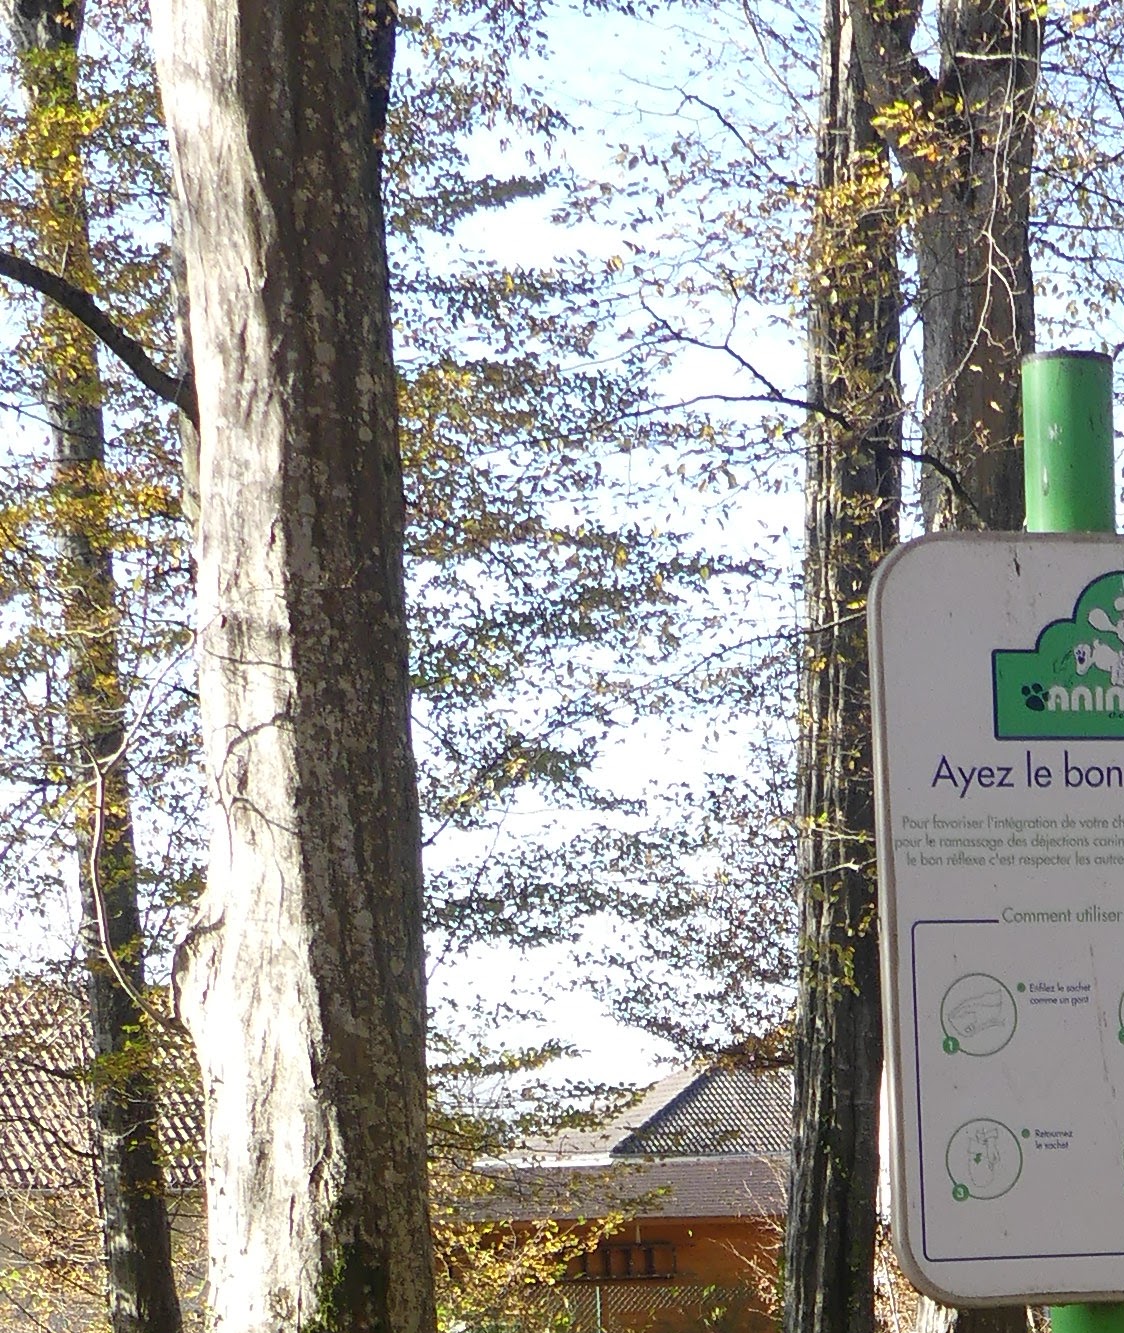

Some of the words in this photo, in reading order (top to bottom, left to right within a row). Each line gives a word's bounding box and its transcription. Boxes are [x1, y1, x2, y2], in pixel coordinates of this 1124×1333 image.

[931, 753, 1015, 799] Ayez
[1026, 750, 1052, 788] le
[1064, 750, 1123, 788] bon
[902, 815, 928, 830] Pour
[932, 814, 984, 830] favoriser
[987, 814, 1058, 832] l'intégration
[1061, 814, 1077, 829] de
[1081, 816, 1109, 829] votre
[894, 836, 922, 851] pour
[925, 833, 936, 848] le
[939, 836, 1004, 851] ramassage
[1007, 833, 1028, 848] des
[1031, 832, 1090, 850] déjections
[906, 851, 917, 866] le
[920, 851, 943, 866] bon
[946, 851, 986, 866] réflexe
[988, 851, 1015, 866] c'est
[1018, 853, 1071, 869] respecter
[1075, 851, 1091, 865] les
[1001, 906, 1071, 924] Comment
[1076, 905, 1124, 923] utiliser
[1057, 981, 1065, 993] le
[1066, 981, 1091, 993] sachet
[1059, 997, 1070, 1005] un
[1035, 1140, 1043, 1149] le
